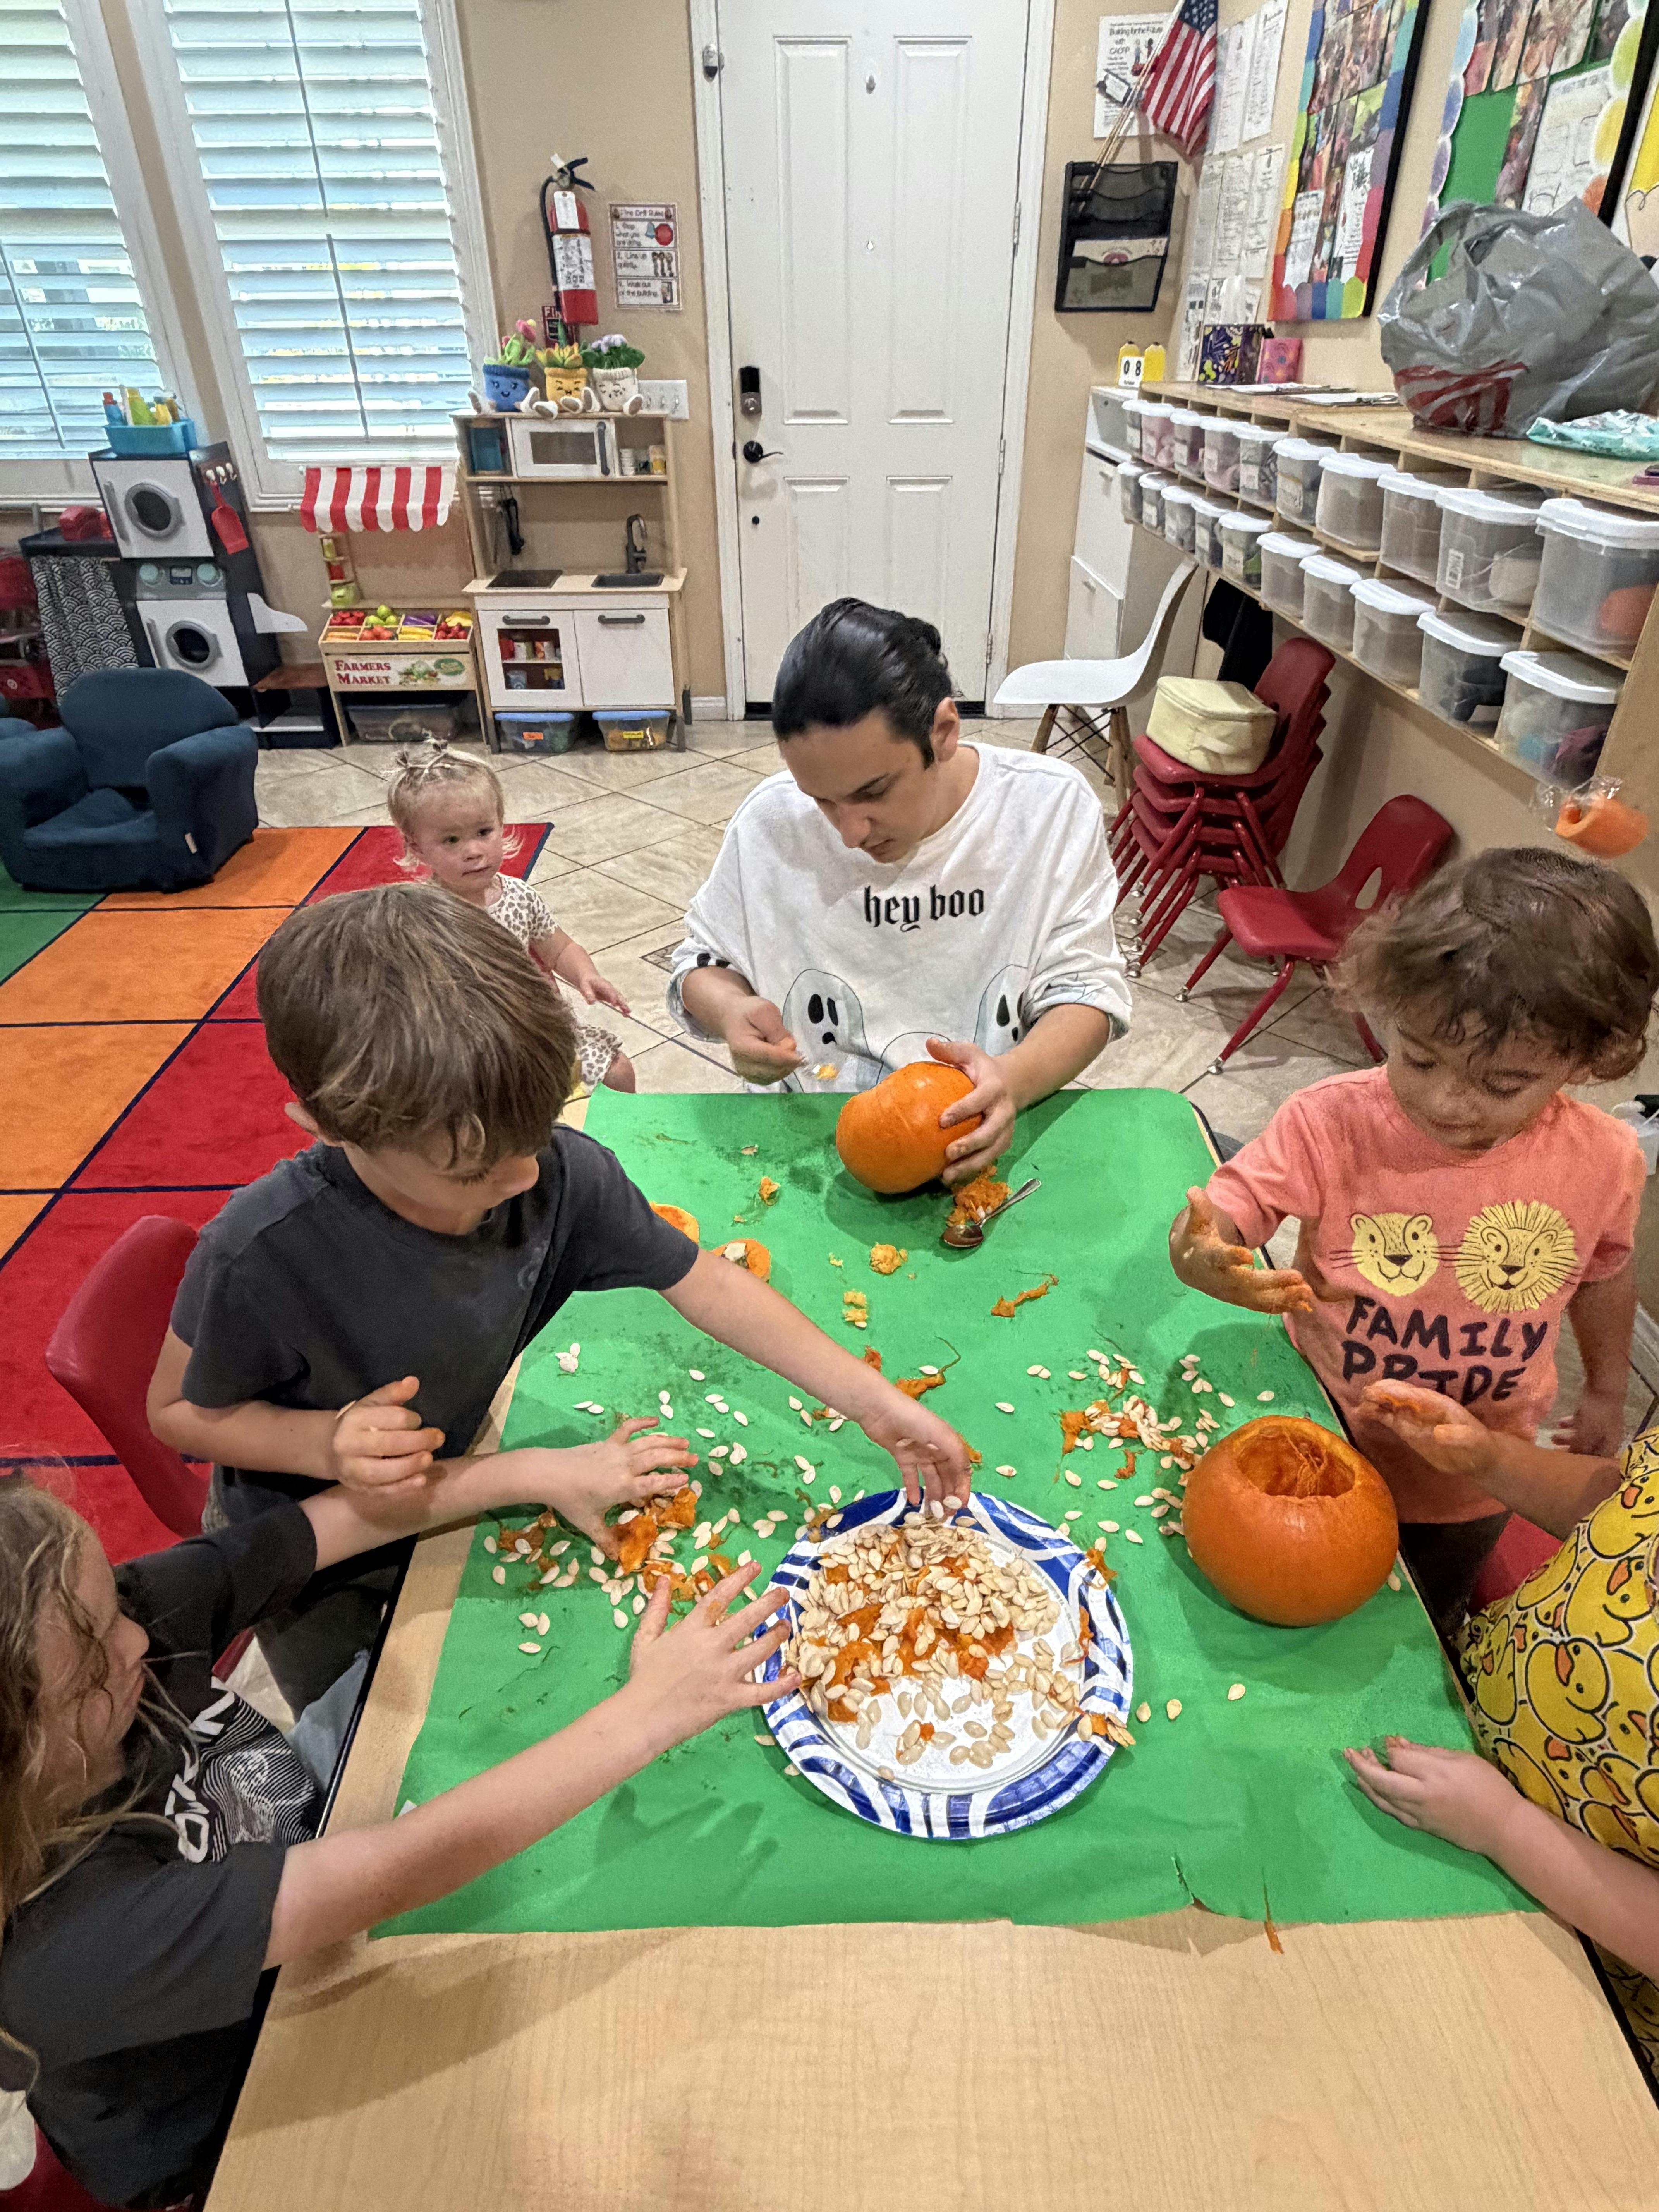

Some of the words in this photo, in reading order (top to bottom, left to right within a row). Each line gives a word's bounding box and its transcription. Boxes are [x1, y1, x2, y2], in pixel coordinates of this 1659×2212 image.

[335, 659, 391, 672] FARMERS
[337, 673, 391, 685] MARKET
[864, 885, 921, 932] hey
[929, 884, 984, 921] boo
[1346, 1294, 1548, 1362] FAMILY
